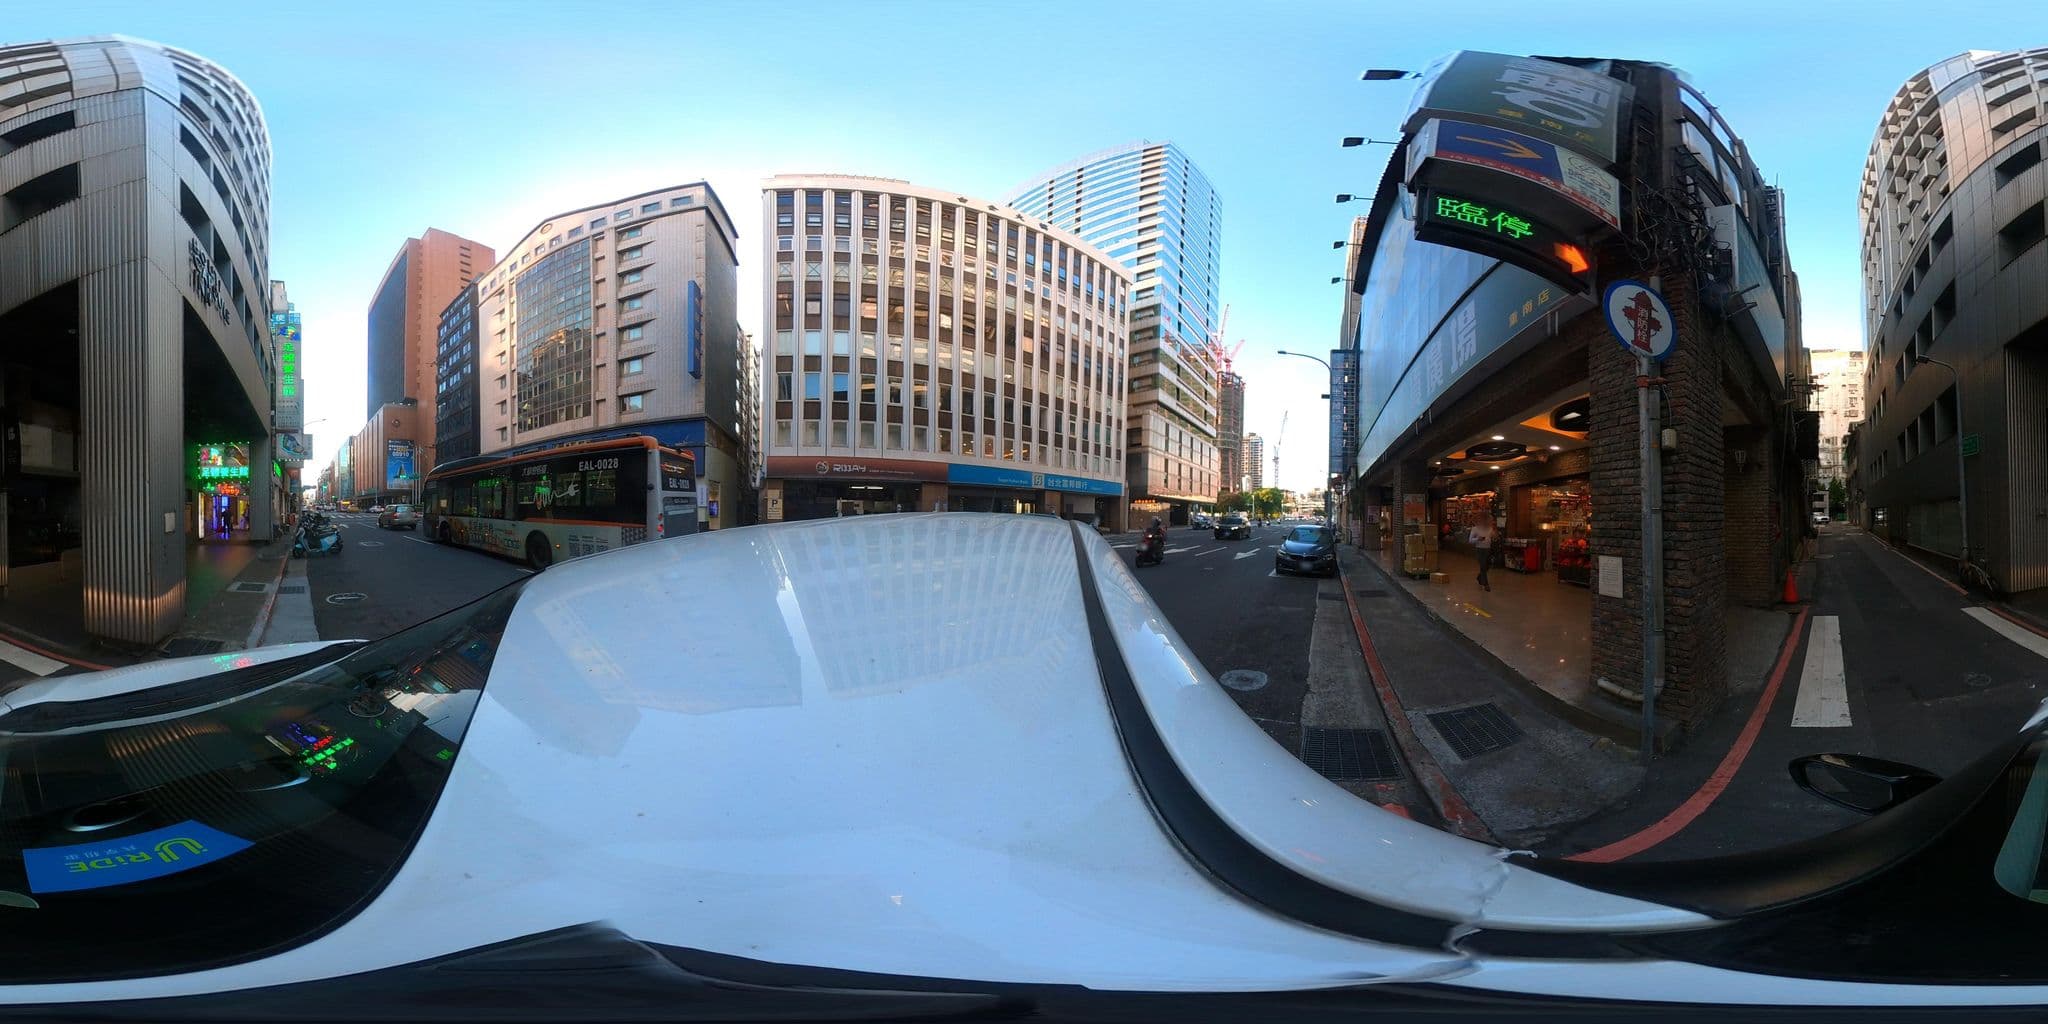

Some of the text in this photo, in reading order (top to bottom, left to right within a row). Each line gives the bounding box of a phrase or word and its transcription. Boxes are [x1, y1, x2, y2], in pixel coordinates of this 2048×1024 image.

[1436, 196, 1534, 239] 臨停
[578, 458, 619, 472] EAL-0028
[771, 499, 778, 508] P
